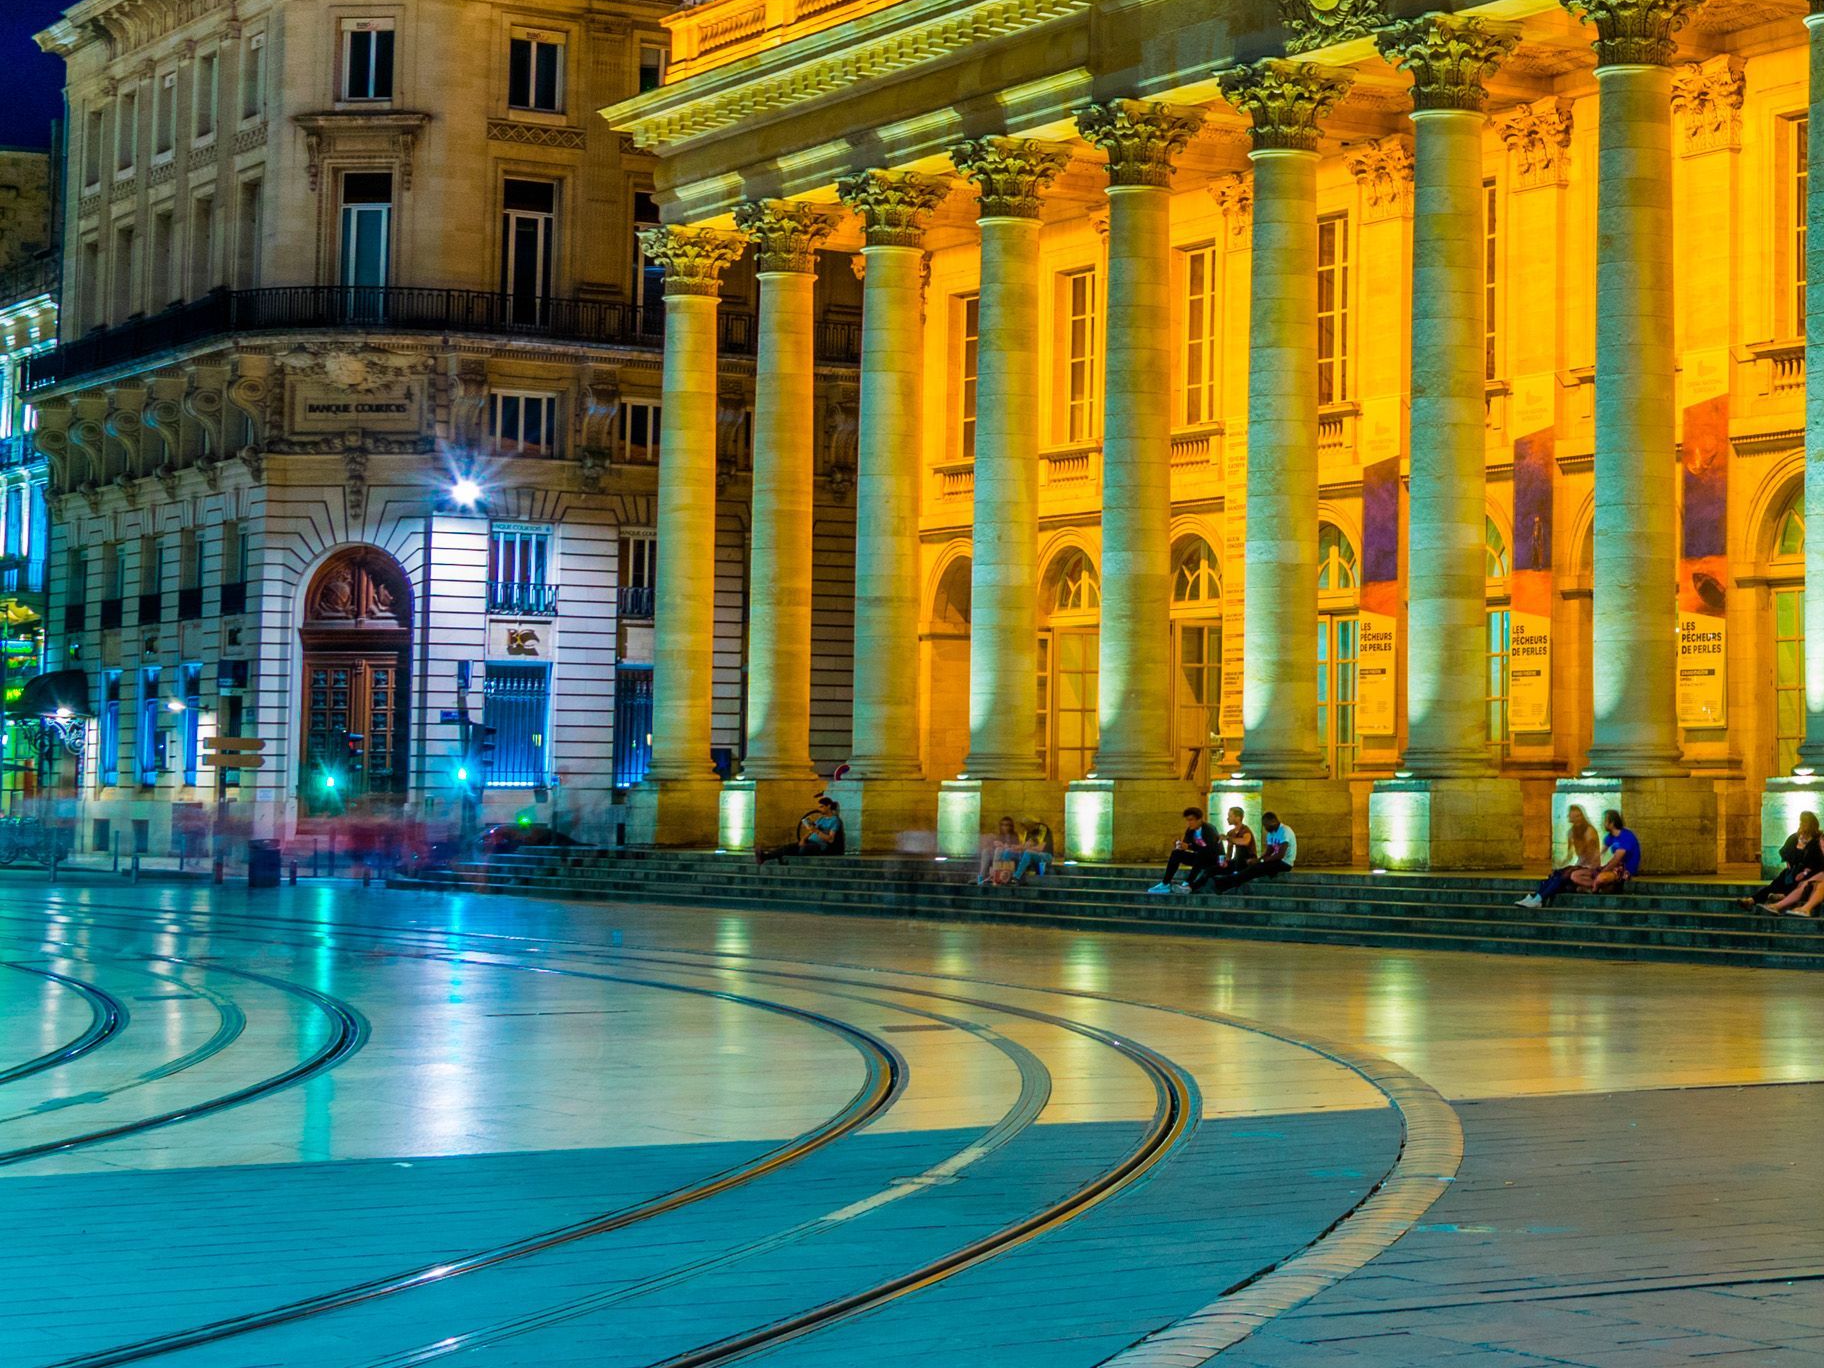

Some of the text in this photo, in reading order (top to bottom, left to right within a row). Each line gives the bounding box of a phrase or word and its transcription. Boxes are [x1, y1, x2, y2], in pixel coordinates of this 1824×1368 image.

[308, 404, 407, 414] BANQUE COURTOIS
[1360, 622, 1371, 631] LES
[1512, 625, 1524, 634] LES
[1681, 621, 1696, 631] LES
[1360, 643, 1392, 652] DE PERLES
[1512, 646, 1547, 656] DE PERLES
[1681, 644, 1722, 654] DE PERLES
